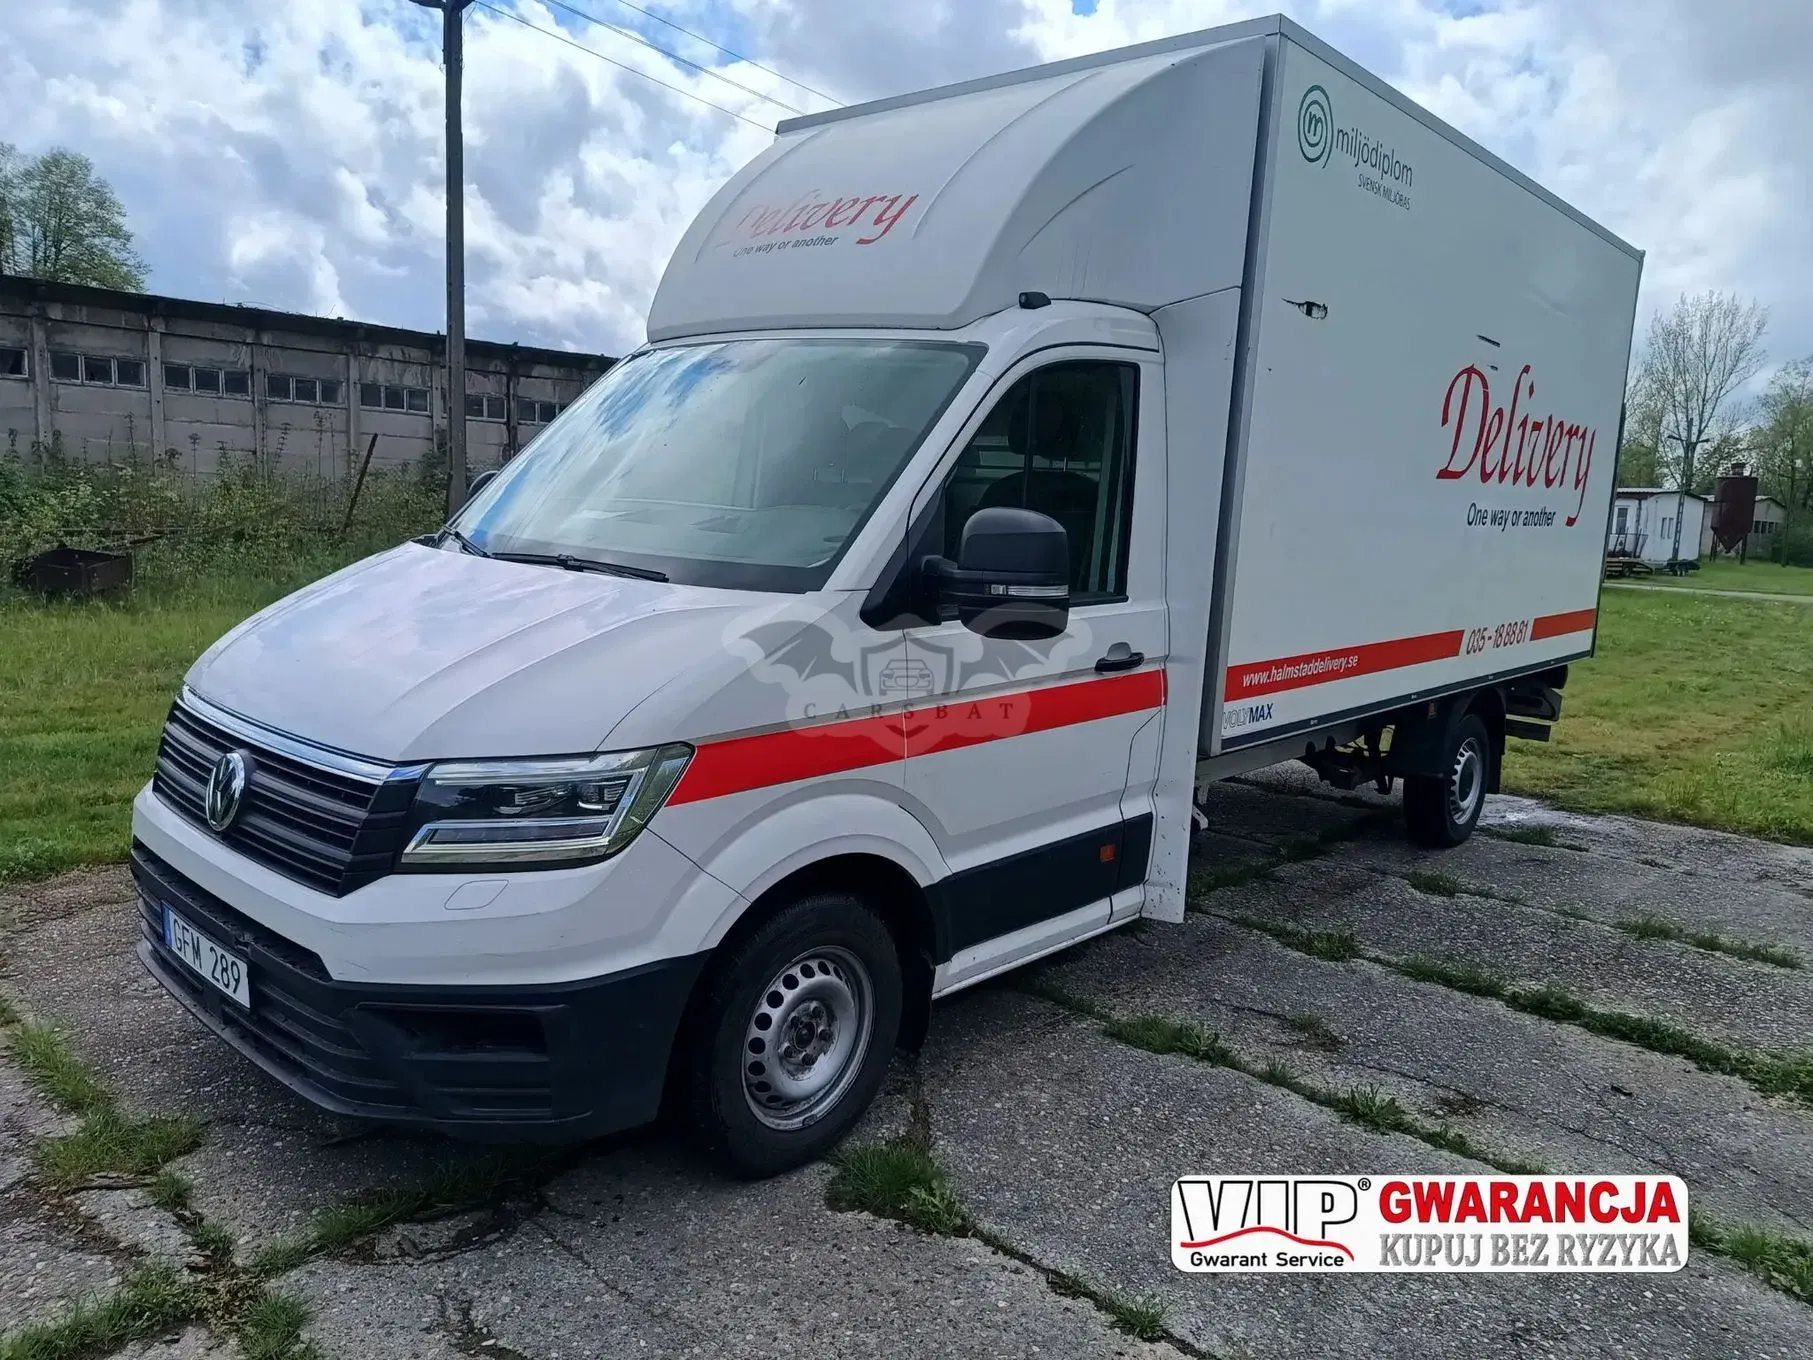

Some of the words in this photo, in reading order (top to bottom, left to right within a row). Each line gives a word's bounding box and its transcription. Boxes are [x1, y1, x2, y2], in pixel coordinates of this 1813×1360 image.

[1336, 127, 1413, 187] miljödiplom
[1358, 173, 1383, 197] SVENSK
[755, 241, 777, 254] way
[777, 240, 791, 250] or
[791, 235, 839, 249] another
[1436, 363, 1597, 527] Delivery
[1467, 502, 1488, 526] One
[1490, 509, 1511, 532] way
[1511, 510, 1522, 526] or
[1522, 506, 1556, 527] another
[1242, 655, 1359, 687] www.halmstaddelivery.se
[173, 918, 203, 971] GFM
[209, 945, 241, 995] 289
